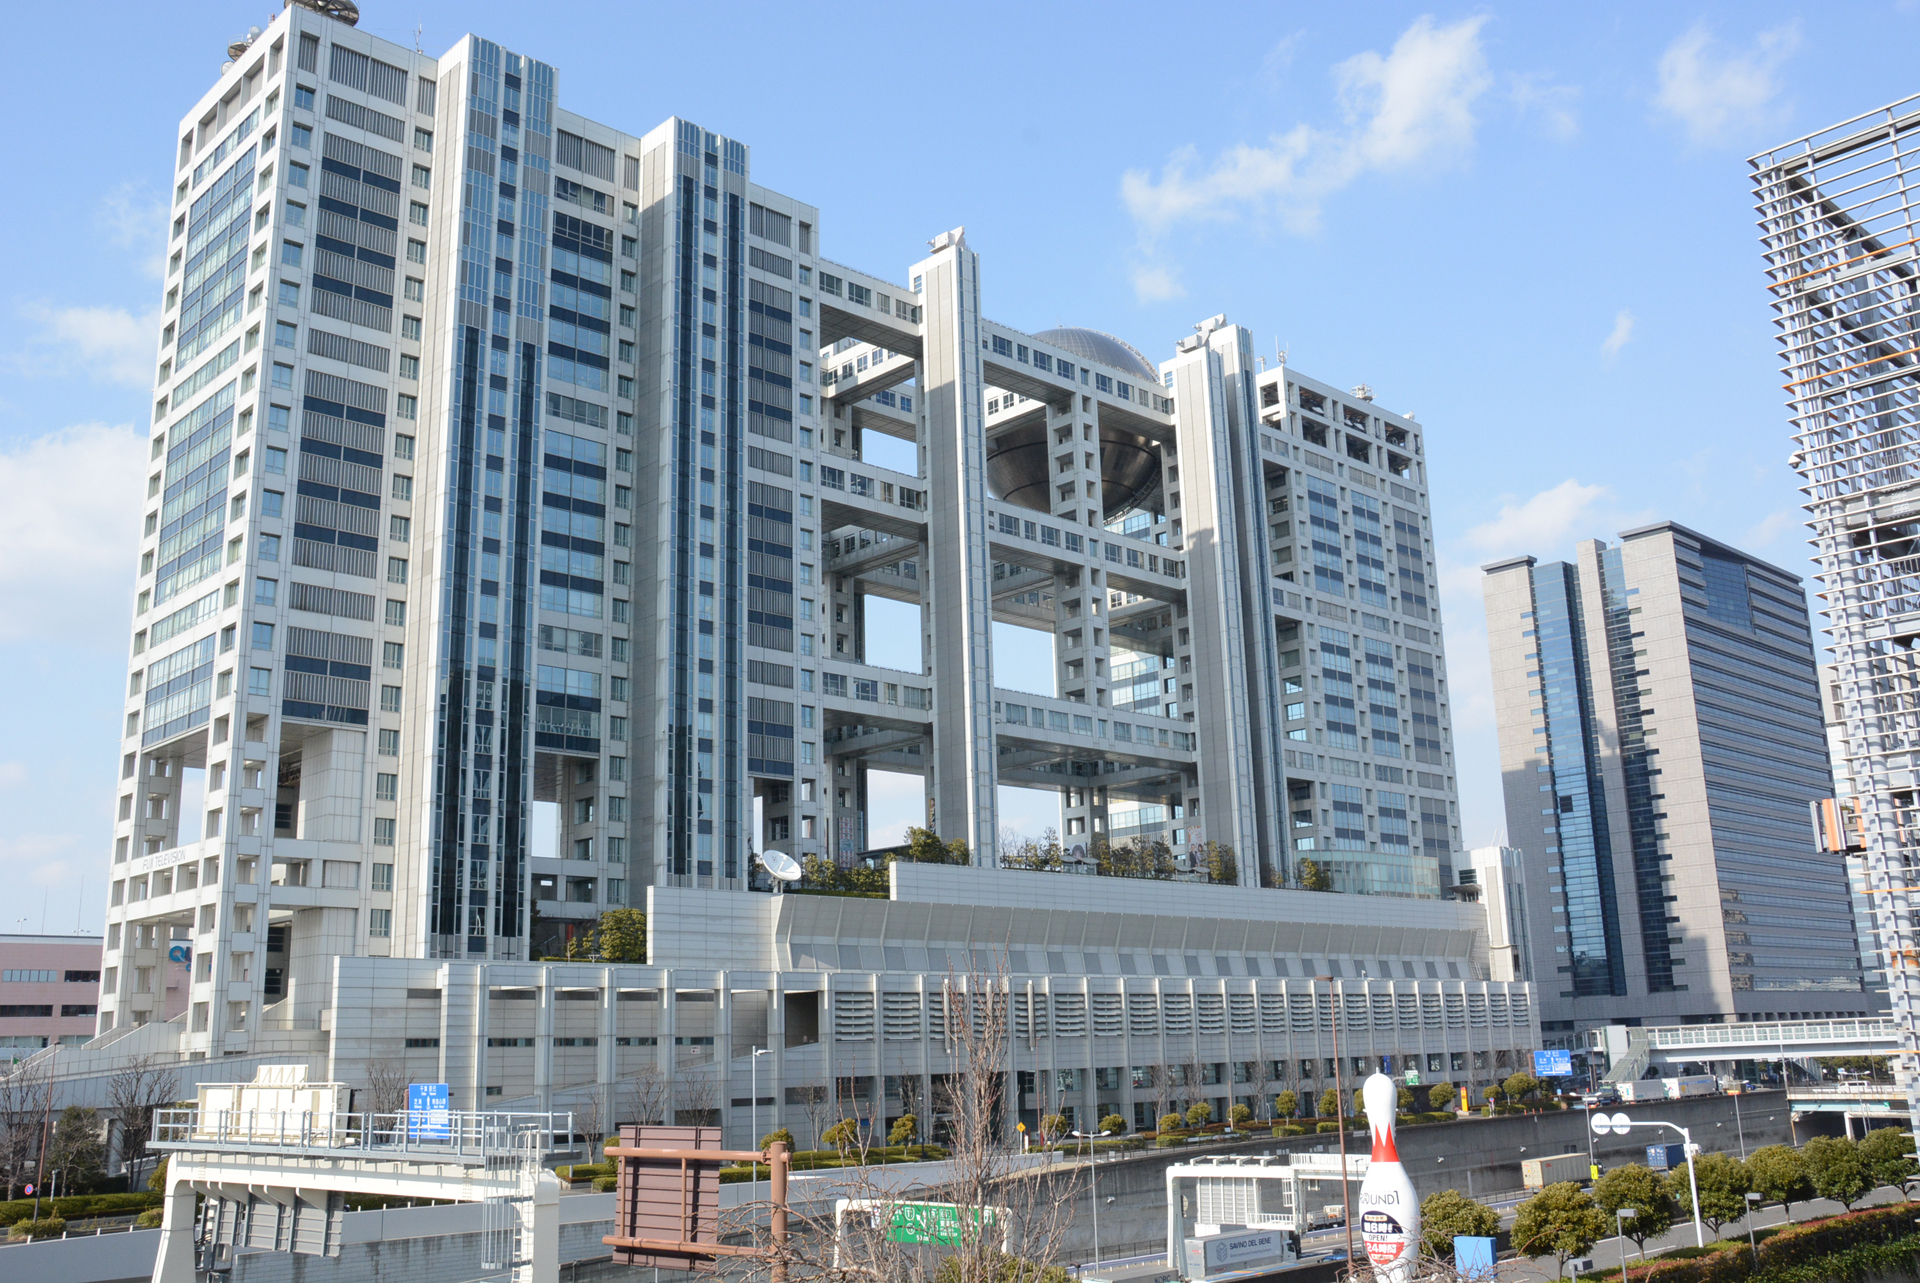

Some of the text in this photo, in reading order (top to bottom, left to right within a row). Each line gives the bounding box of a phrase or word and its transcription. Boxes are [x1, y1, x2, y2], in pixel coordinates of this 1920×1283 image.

[155, 848, 187, 867] TELEVISION
[1229, 1236, 1272, 1250] SAVINO DEL BENE
[1368, 1233, 1388, 1242] OPEN!
[1366, 1242, 1397, 1254] 24時間
